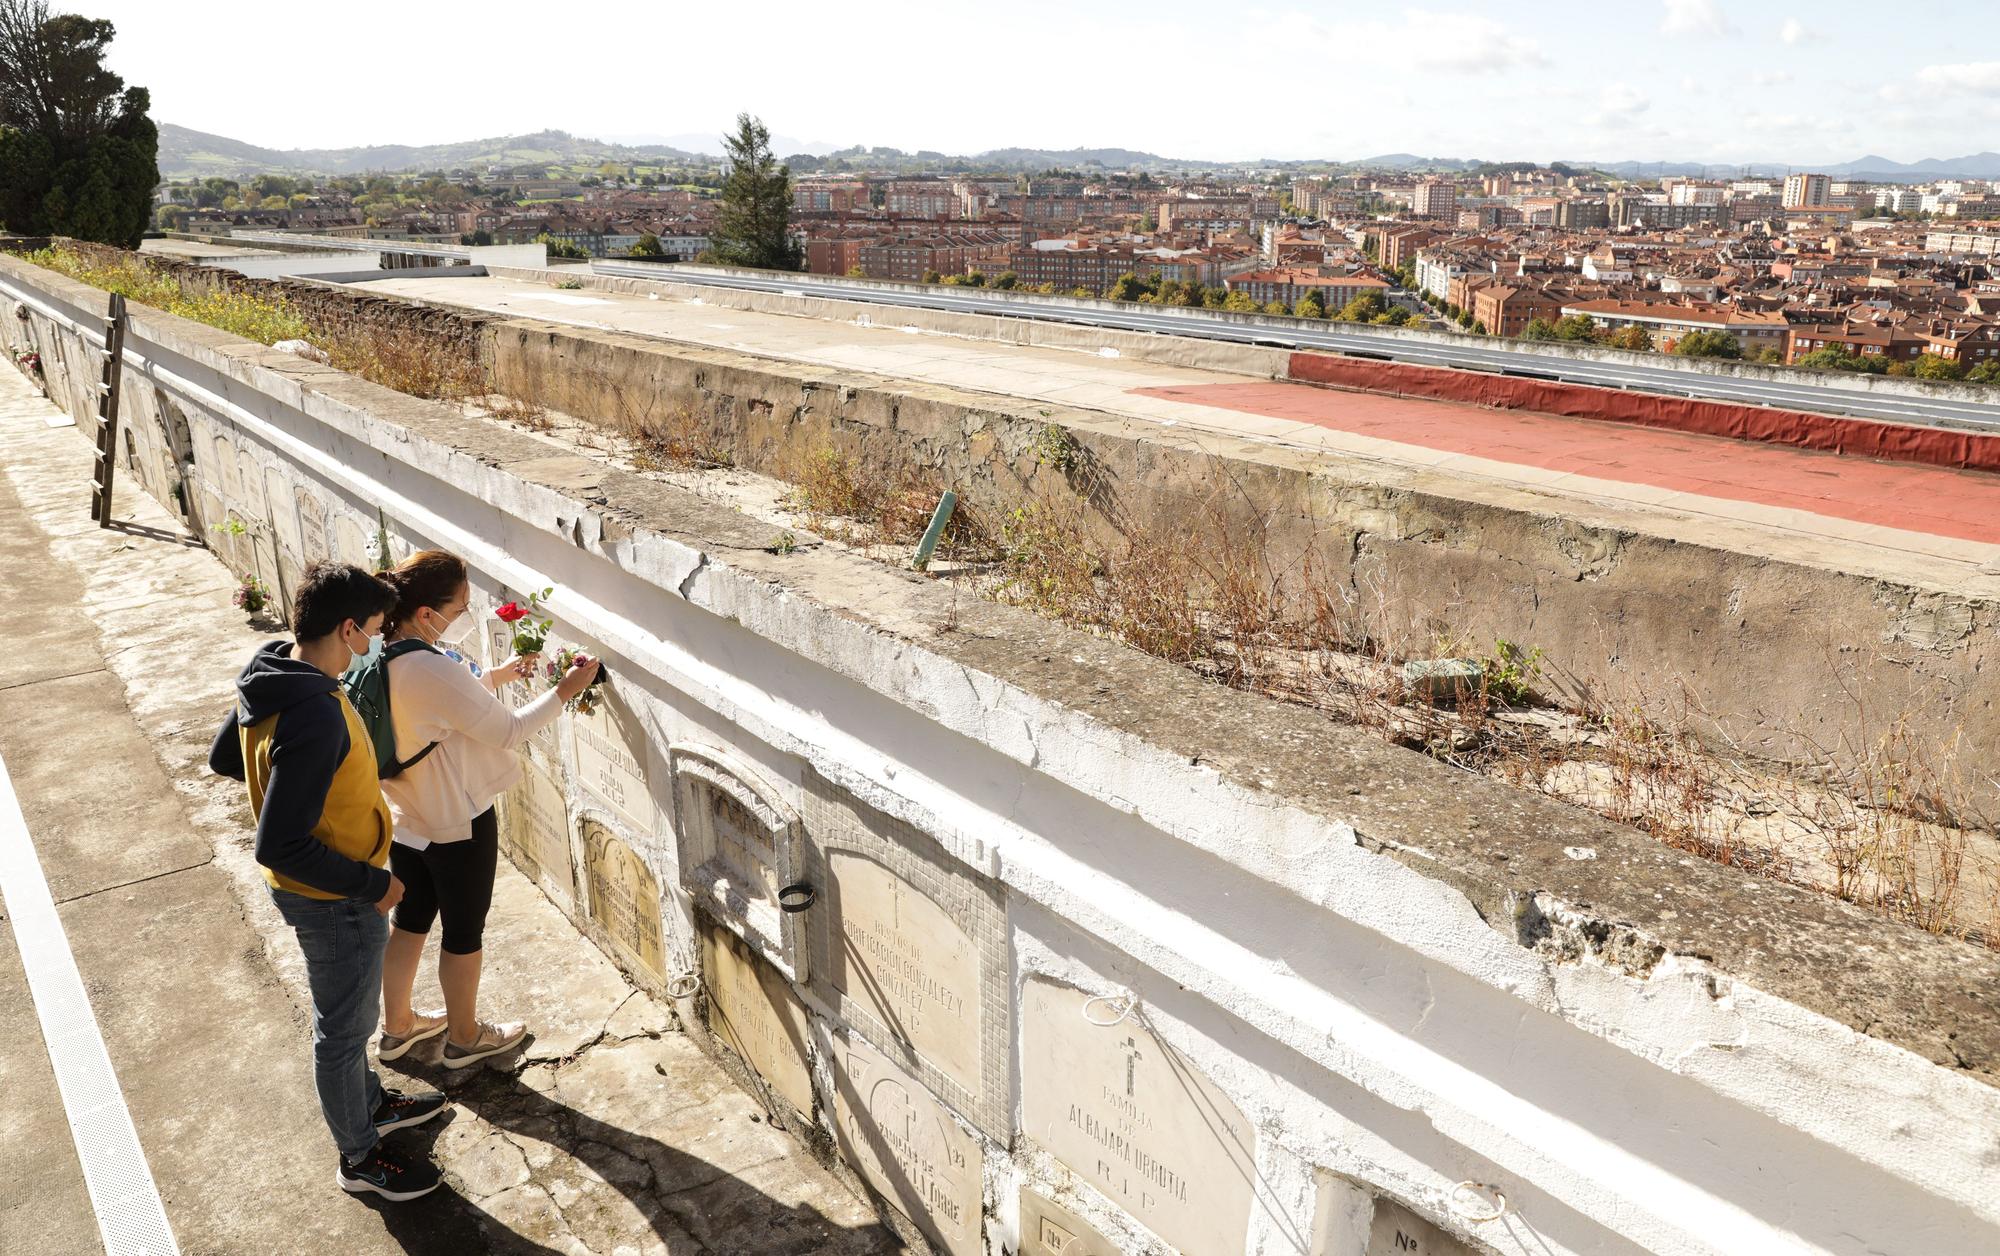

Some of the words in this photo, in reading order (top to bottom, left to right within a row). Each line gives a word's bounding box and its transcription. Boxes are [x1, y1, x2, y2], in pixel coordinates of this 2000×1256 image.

[876, 964, 924, 1015] GONZALEZ
[904, 960, 954, 1012] GONZALEZ
[956, 997, 963, 1018] Y
[1103, 1085, 1153, 1132] FAMILIA
[1069, 1103, 1131, 1165] ALBAJARA
[1135, 1148, 1187, 1205] URRUTIA
